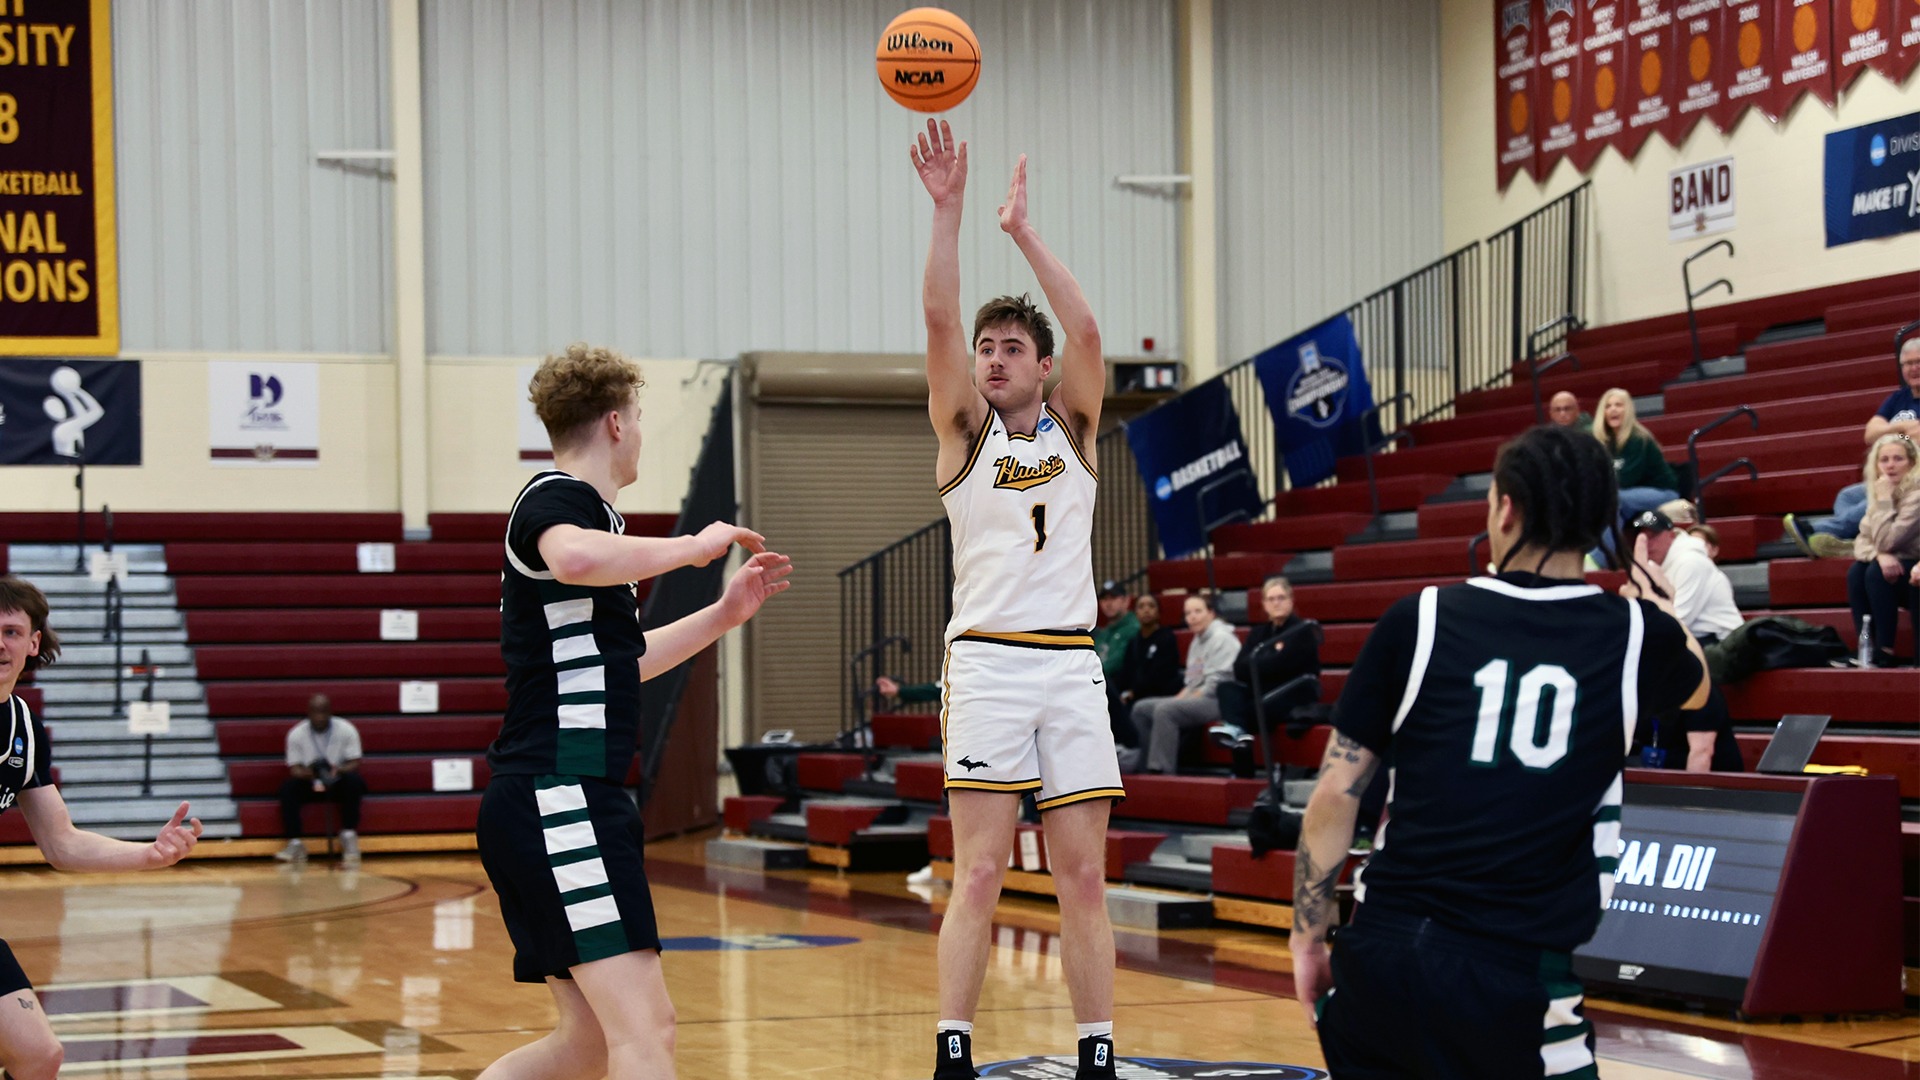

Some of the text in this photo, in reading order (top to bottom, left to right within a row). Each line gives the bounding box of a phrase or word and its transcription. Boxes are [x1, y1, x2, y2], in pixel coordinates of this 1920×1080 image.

[0, 23, 76, 67] SITY
[887, 32, 954, 55] Wilson
[1850, 28, 1879, 50] WALSH
[1792, 49, 1819, 70] WALSH
[1843, 40, 1888, 65] UNIVERSITY
[895, 69, 945, 85] NCAA
[1737, 66, 1763, 85] WALSH
[1783, 60, 1828, 84] UNIVERSITY
[1688, 82, 1713, 98] WALSH
[1729, 76, 1771, 98] UNIVERSITY
[1680, 91, 1719, 112] UNIVERSITY
[0, 92, 20, 145] 8
[1631, 106, 1669, 127] UNIVERSITY
[1672, 164, 1731, 215] BAND
[1852, 186, 1892, 217] MAKE
[1892, 182, 1910, 208] IT
[0, 259, 90, 303] ONS
[1169, 439, 1243, 492] BASKETBALL
[1029, 503, 1048, 554] 1
[1468, 657, 1579, 770] 10
[1661, 843, 1717, 892] DII
[1664, 903, 1762, 926] TOURNAMENT
